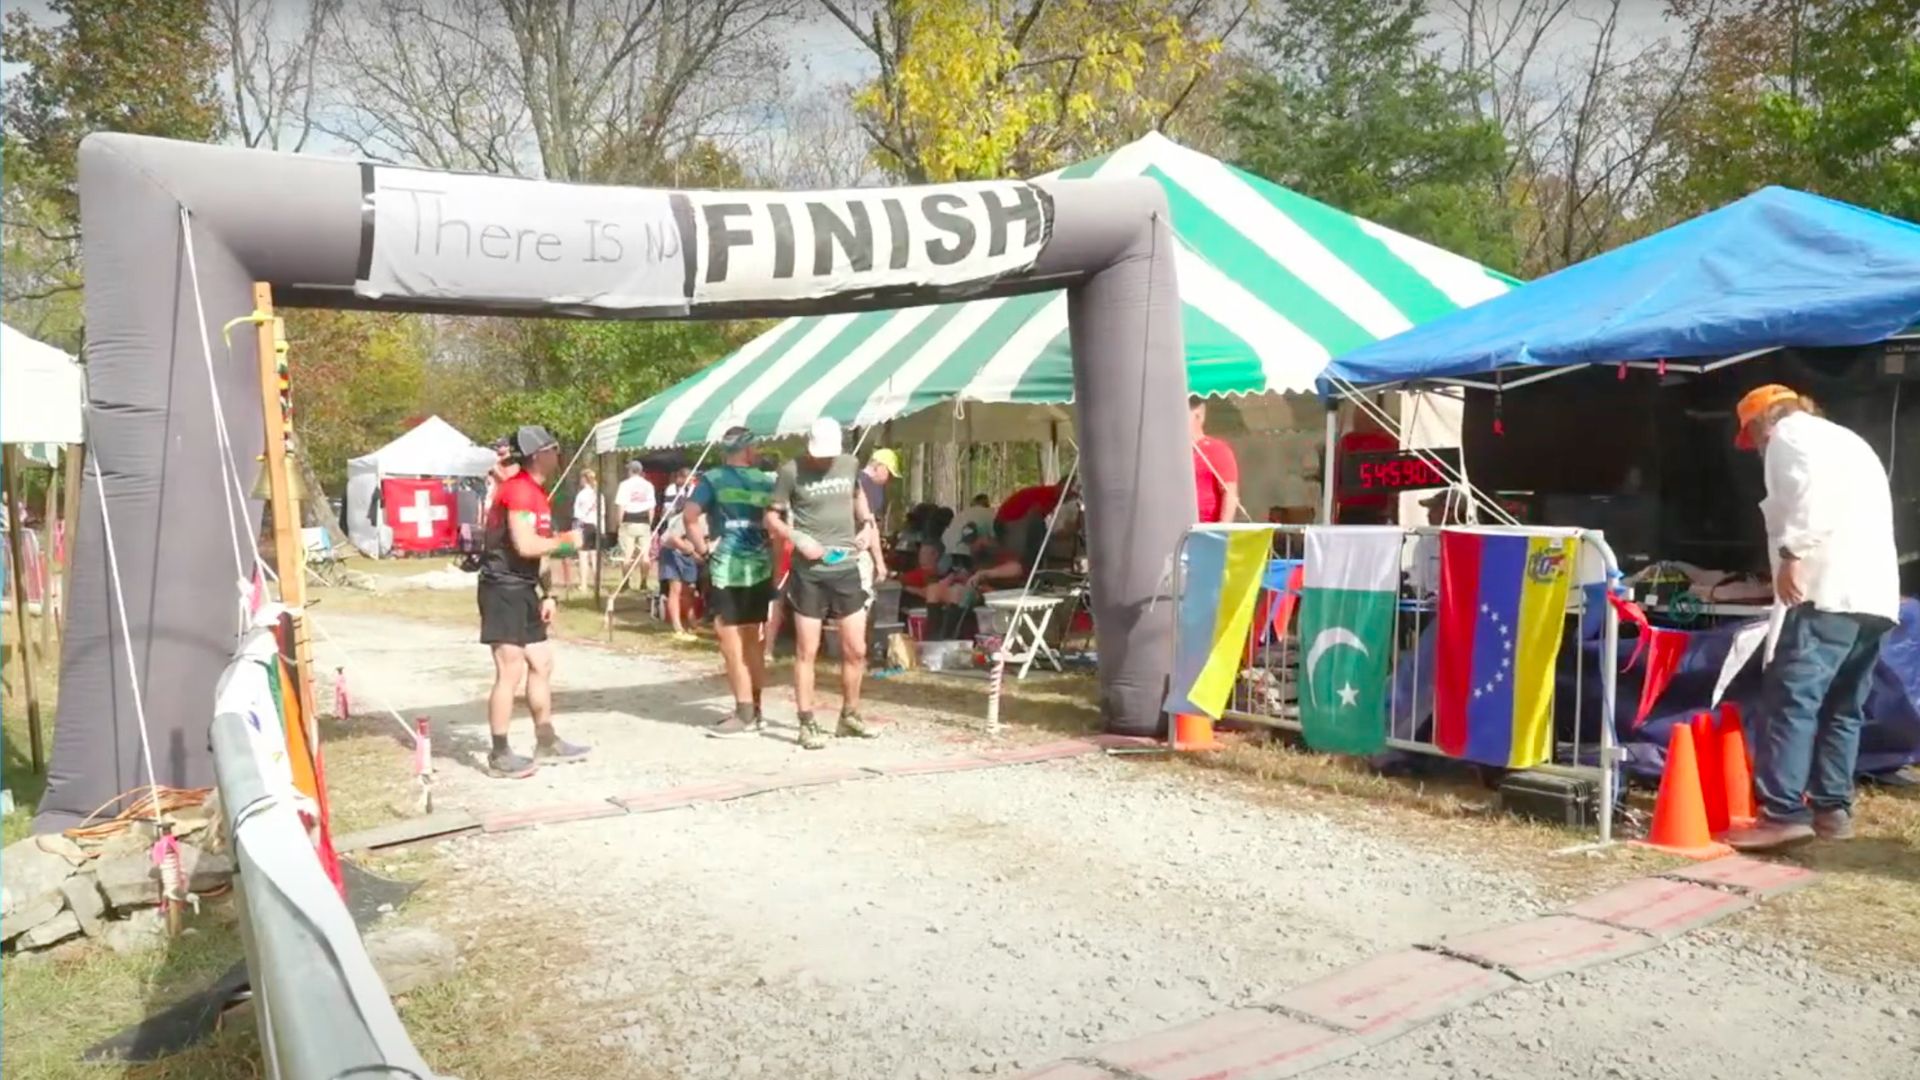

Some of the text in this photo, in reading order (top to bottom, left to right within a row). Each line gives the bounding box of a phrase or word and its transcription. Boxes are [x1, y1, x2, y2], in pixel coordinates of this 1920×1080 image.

[379, 186, 562, 263] There
[582, 219, 624, 263] IS
[702, 186, 1044, 284] FINISH
